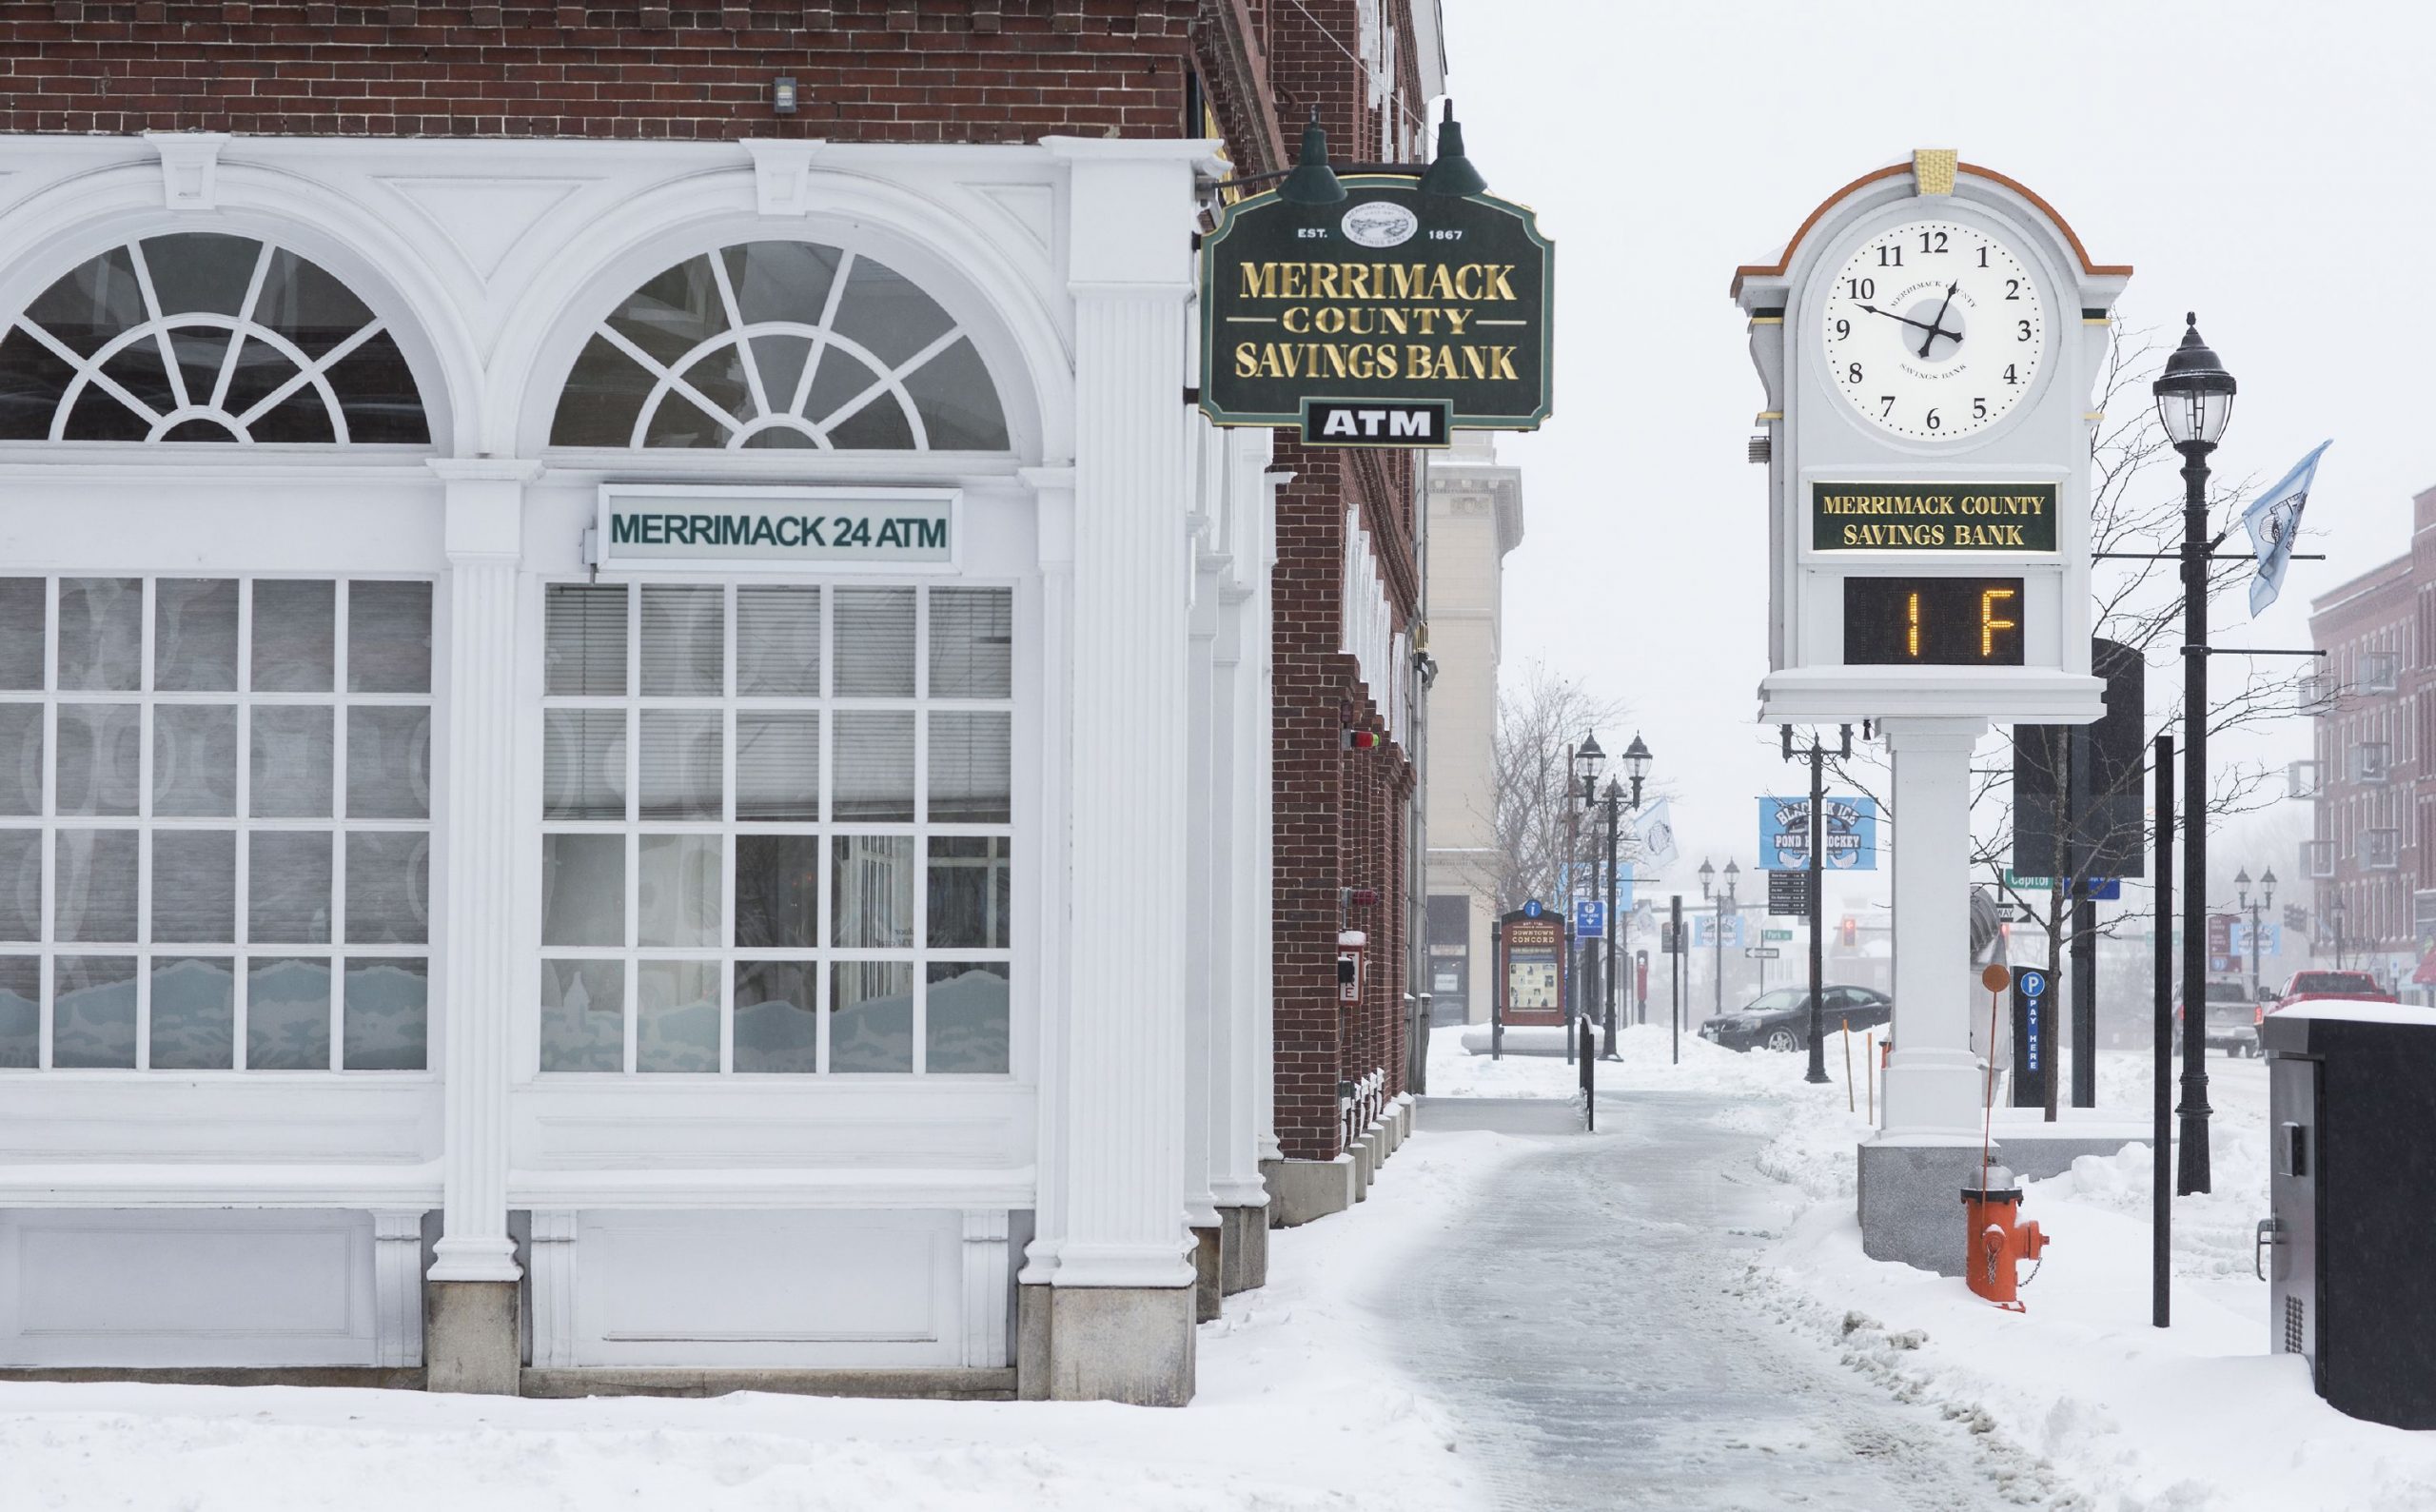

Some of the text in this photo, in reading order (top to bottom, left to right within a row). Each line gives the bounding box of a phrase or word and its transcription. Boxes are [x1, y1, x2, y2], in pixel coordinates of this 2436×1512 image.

[1298, 228, 1327, 239] EST.
[1429, 230, 1463, 241] 1867
[1919, 232, 1948, 253] 12
[1877, 245, 1903, 266] 11
[1976, 246, 1989, 267] 1
[1240, 263, 1517, 301] MERRIMACK
[1847, 278, 1875, 300] 10
[2006, 280, 2019, 300] 2
[1283, 307, 1474, 335] COUNTY
[1837, 320, 1850, 341] 9
[2018, 321, 2031, 342] 3
[1235, 343, 1519, 380] SAVINGS BANK
[1850, 363, 1862, 383] 8
[2004, 364, 2017, 384] 4
[1880, 396, 1896, 418] 7
[1973, 398, 1987, 419] 5
[1324, 410, 1431, 437] ATM
[1927, 408, 1939, 429] 6
[1823, 496, 2046, 515] MERRIMACK COUNTY
[612, 514, 946, 548] MERRIMACK 24 ATM
[1843, 524, 2024, 545] SAVINGS BANK
[1908, 589, 2015, 657] 1 F
[1837, 805, 1859, 826] ICE
[1776, 835, 1801, 847] POND
